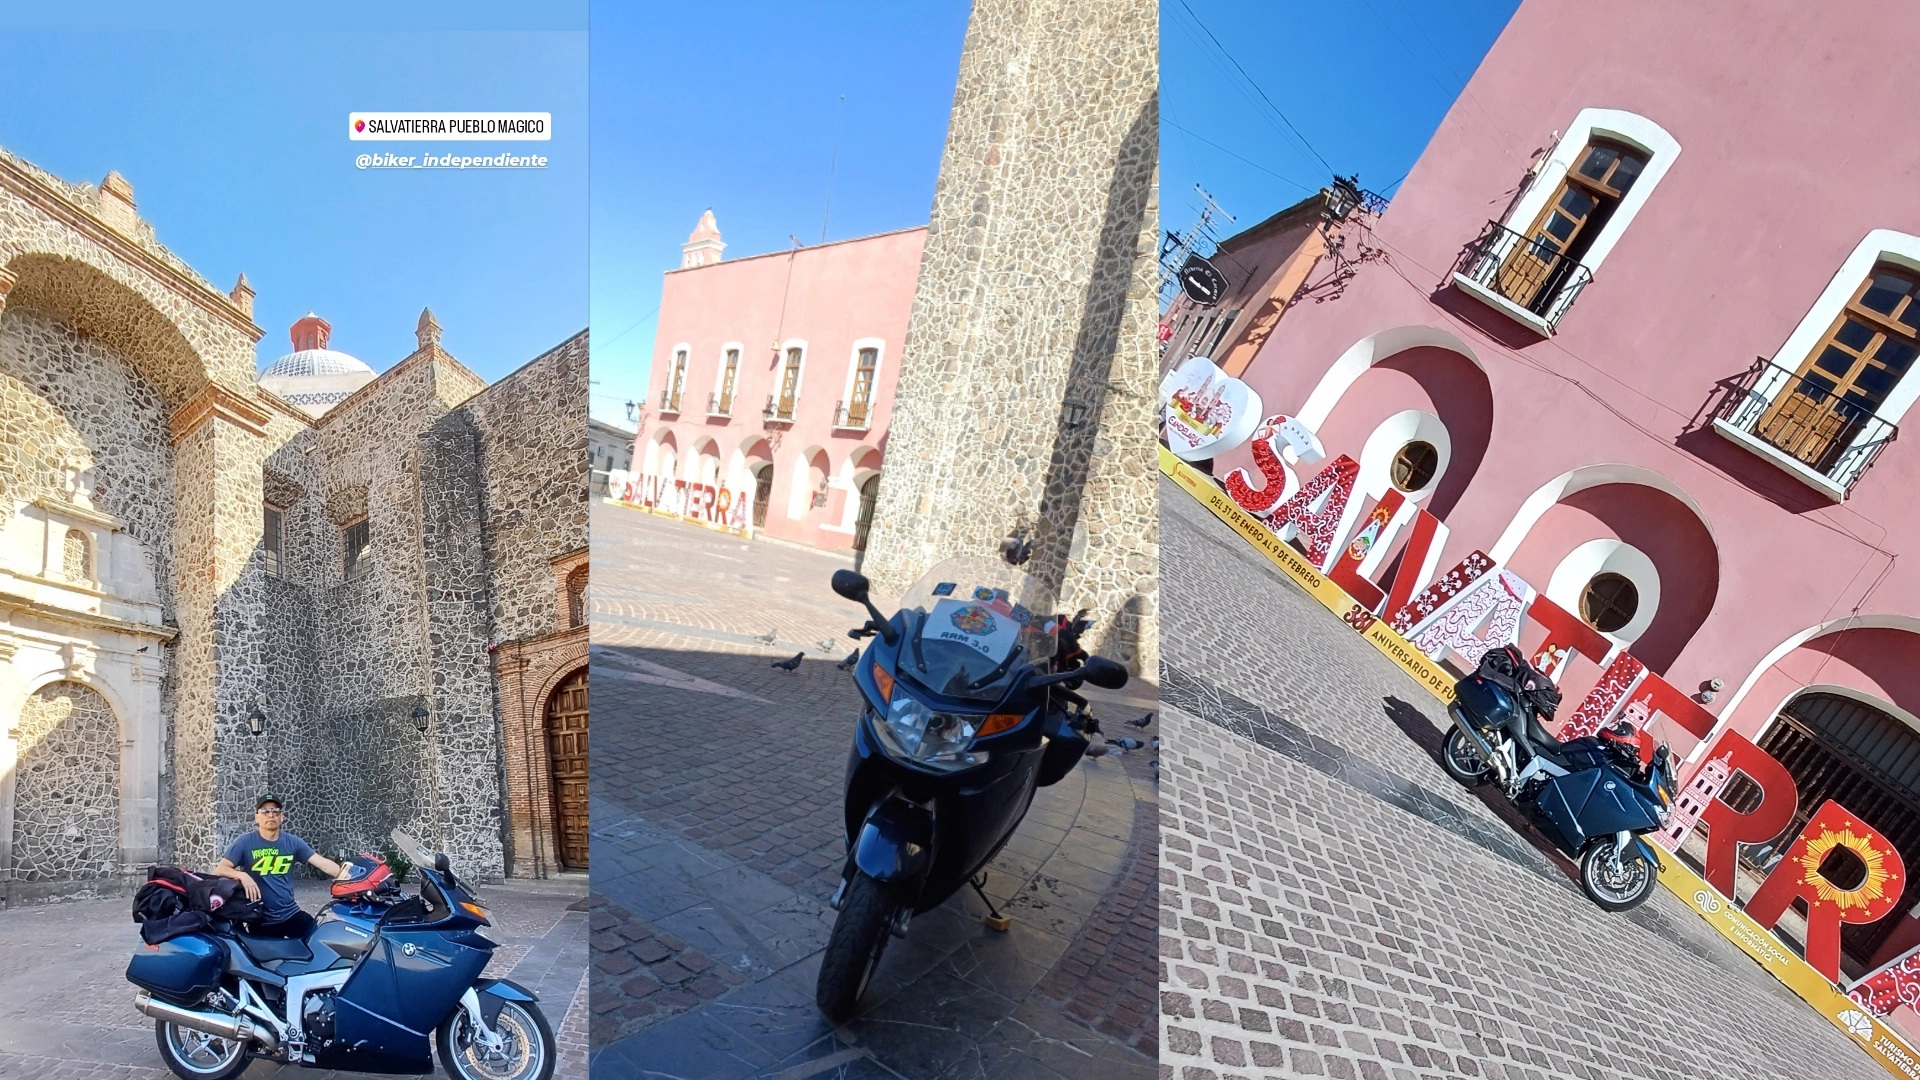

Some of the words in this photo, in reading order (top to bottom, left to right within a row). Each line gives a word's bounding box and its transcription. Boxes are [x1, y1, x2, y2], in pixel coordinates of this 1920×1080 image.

[623, 473, 747, 529] SALVATIERRA
[1210, 496, 1222, 510] DEL
[1222, 505, 1232, 516] 31
[1230, 512, 1241, 524] DE
[1241, 519, 1264, 542] ENERO
[1262, 538, 1270, 550] AL
[1272, 546, 1278, 554] 9
[1277, 550, 1289, 562] DE
[1287, 558, 1321, 588] FEBRERO
[940, 632, 969, 643] RRM
[973, 640, 990, 654] 3.0
[1343, 604, 1377, 634] 381
[1372, 630, 1429, 678] ANIVERSARIO
[1428, 676, 1443, 690] DE
[1441, 686, 1457, 700] FU
[252, 854, 294, 876] 46
[1724, 911, 1768, 948] COMUNICACIÓN
[1768, 946, 1790, 966] SOCIAL
[1734, 930, 1772, 963] INFORMÁTICA
[1872, 1041, 1920, 1080] SALVATIERRA
[1880, 1035, 1914, 1066] TURISMO
